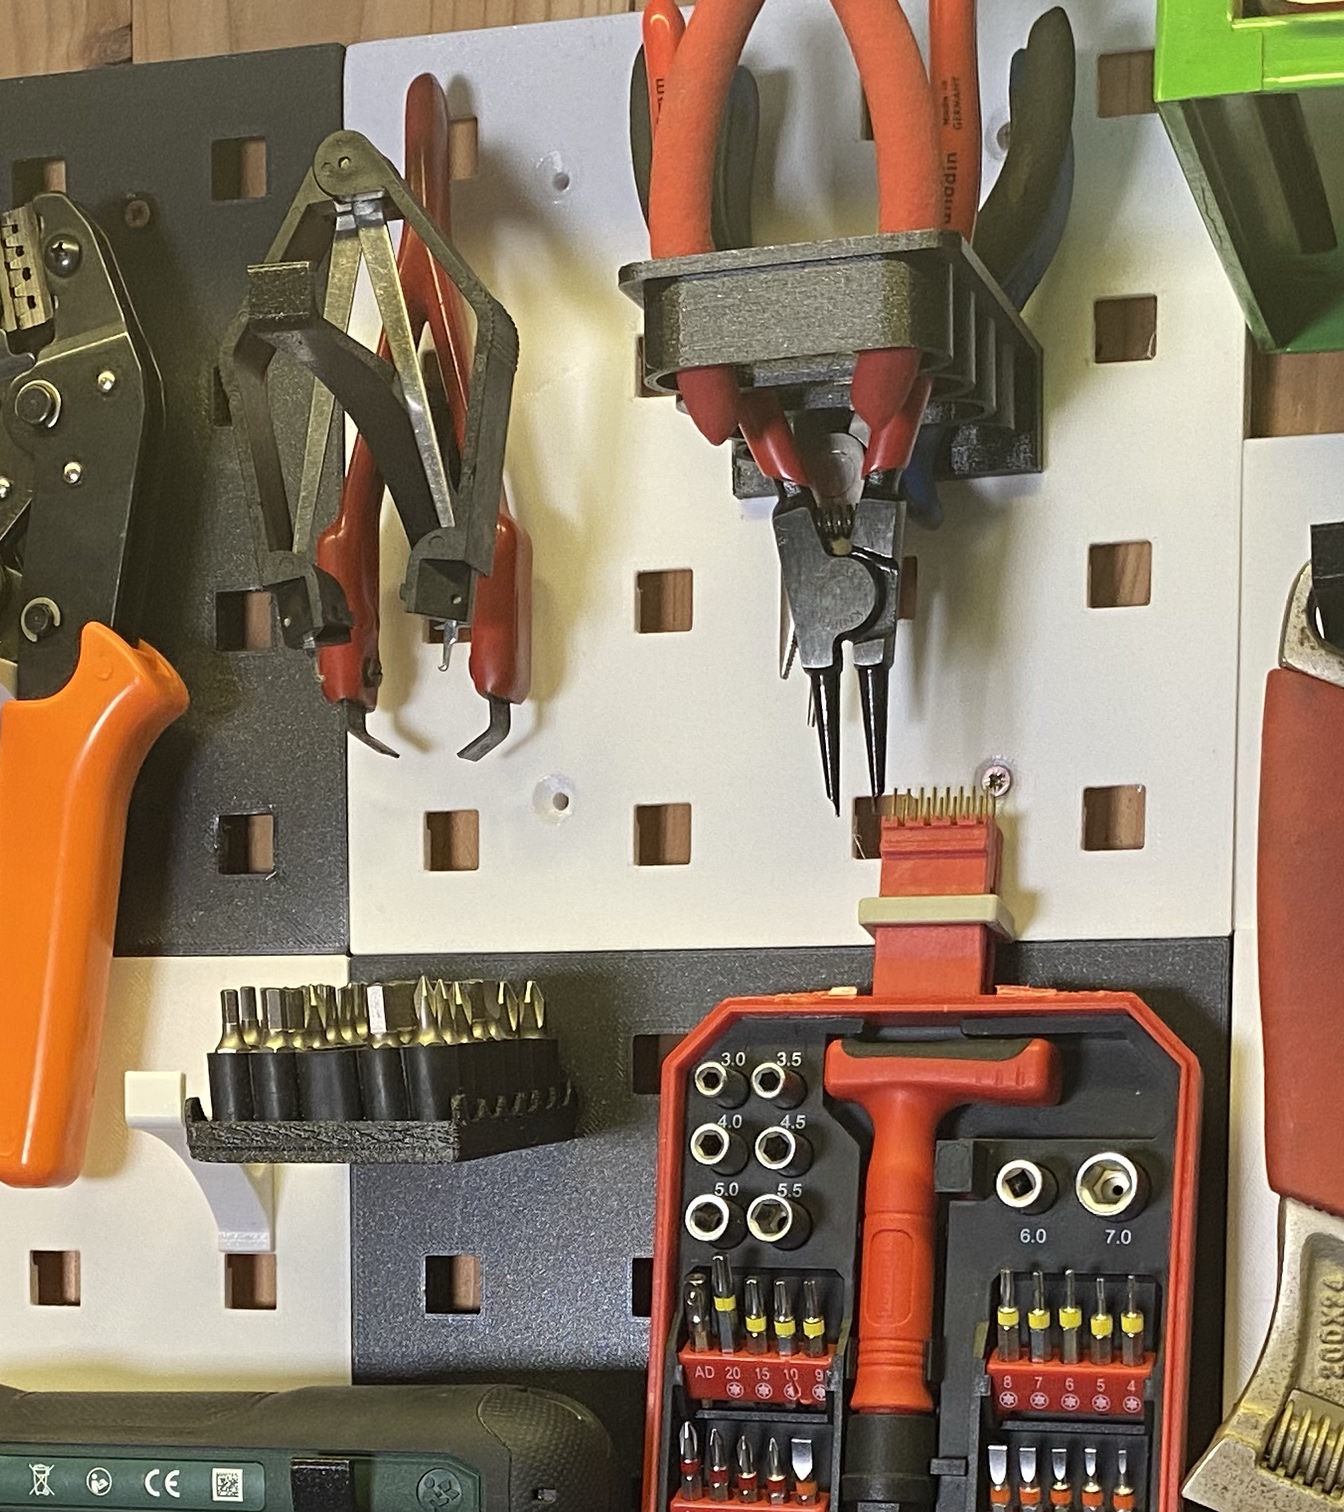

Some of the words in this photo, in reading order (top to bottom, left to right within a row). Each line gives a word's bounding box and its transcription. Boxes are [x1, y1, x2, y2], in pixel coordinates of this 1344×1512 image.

[721, 1052, 746, 1067] 3.0
[776, 1052, 802, 1067] 3.5
[717, 1114, 743, 1128] 4.0
[780, 1115, 806, 1129] 4.5
[714, 1182, 739, 1196] 5.0
[776, 1184, 803, 1197] 5.5
[1020, 1228, 1046, 1243] 6.0
[1105, 1229, 1131, 1244] 7.0
[695, 1365, 715, 1378] AD
[725, 1367, 740, 1380] 20
[755, 1367, 770, 1380] 15
[783, 1368, 798, 1381] 10
[815, 1369, 824, 1382] 9
[1003, 1376, 1012, 1389] 8
[1034, 1377, 1043, 1389] 7
[1065, 1378, 1074, 1391] 6
[1096, 1379, 1105, 1391] 5
[1127, 1380, 1136, 1392] 4
